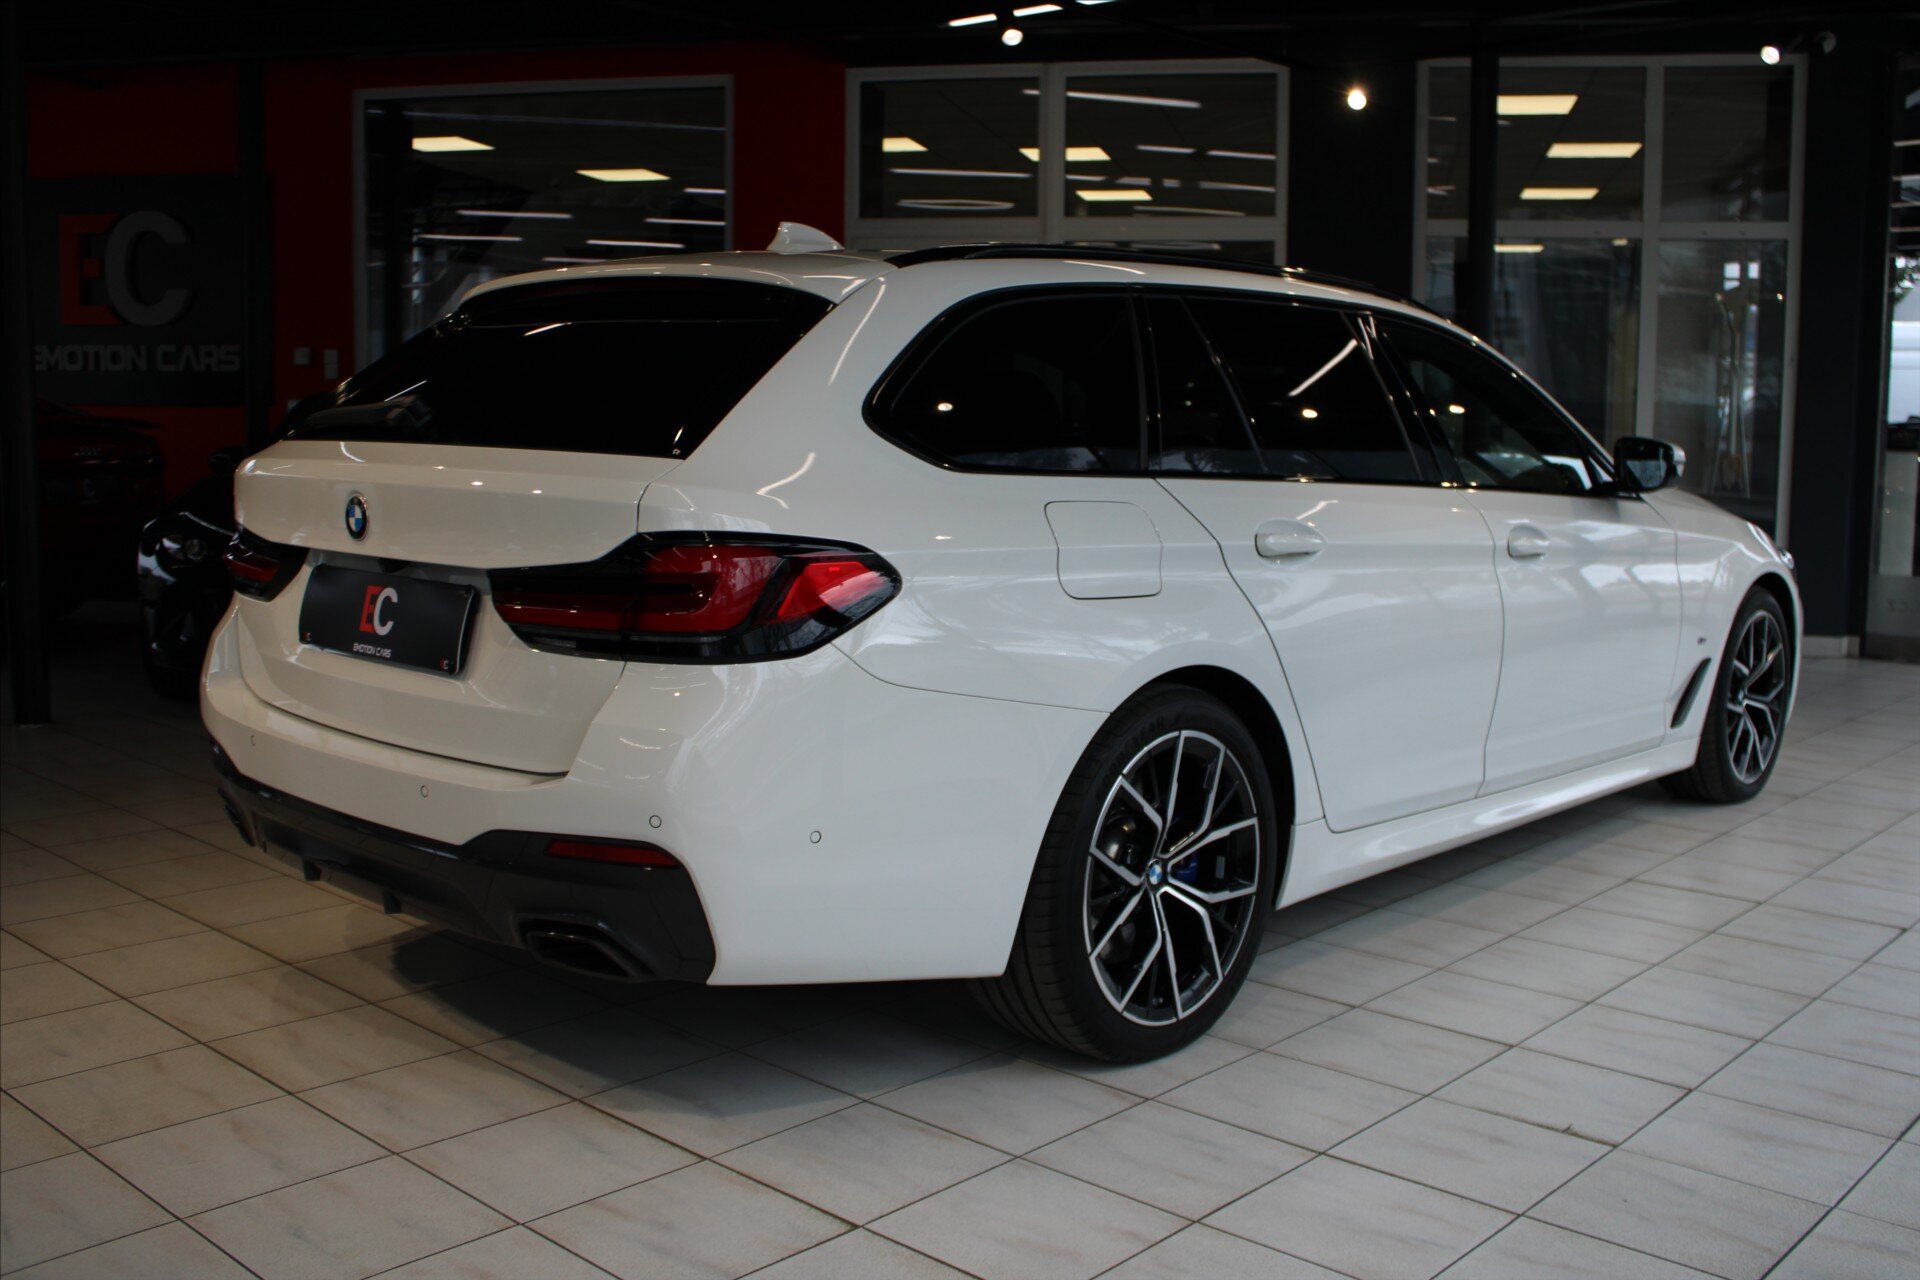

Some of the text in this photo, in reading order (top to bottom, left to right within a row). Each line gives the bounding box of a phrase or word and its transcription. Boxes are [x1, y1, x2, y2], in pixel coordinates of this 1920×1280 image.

[156, 344, 241, 372] CARS
[359, 584, 398, 636] EC
[376, 647, 392, 658] CARS
